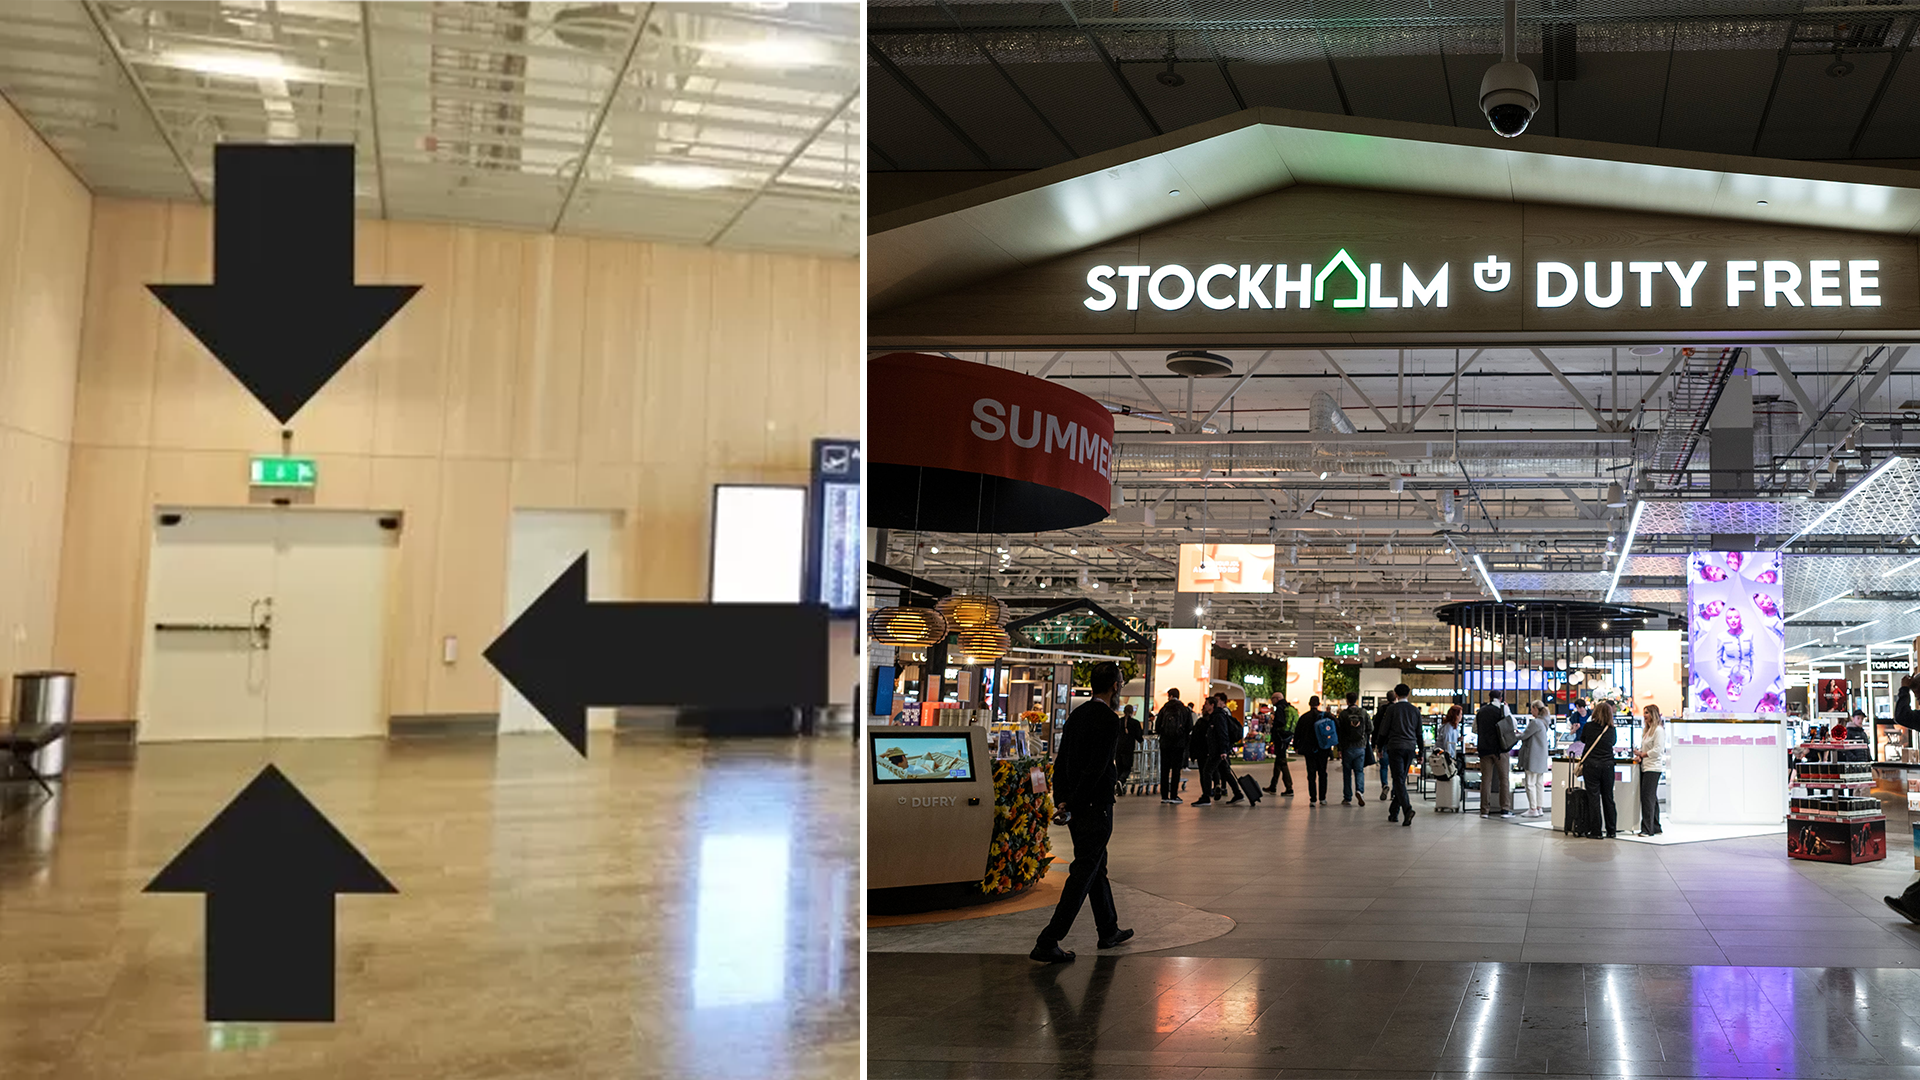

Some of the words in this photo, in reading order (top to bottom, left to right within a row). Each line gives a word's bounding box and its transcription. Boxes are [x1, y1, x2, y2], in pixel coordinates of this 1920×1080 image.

[1536, 260, 1706, 309] DUTY
[1726, 258, 1881, 308] FREE
[1871, 661, 1888, 669] TOM
[1888, 661, 1909, 669] FORD
[912, 796, 957, 808] DUFRY
